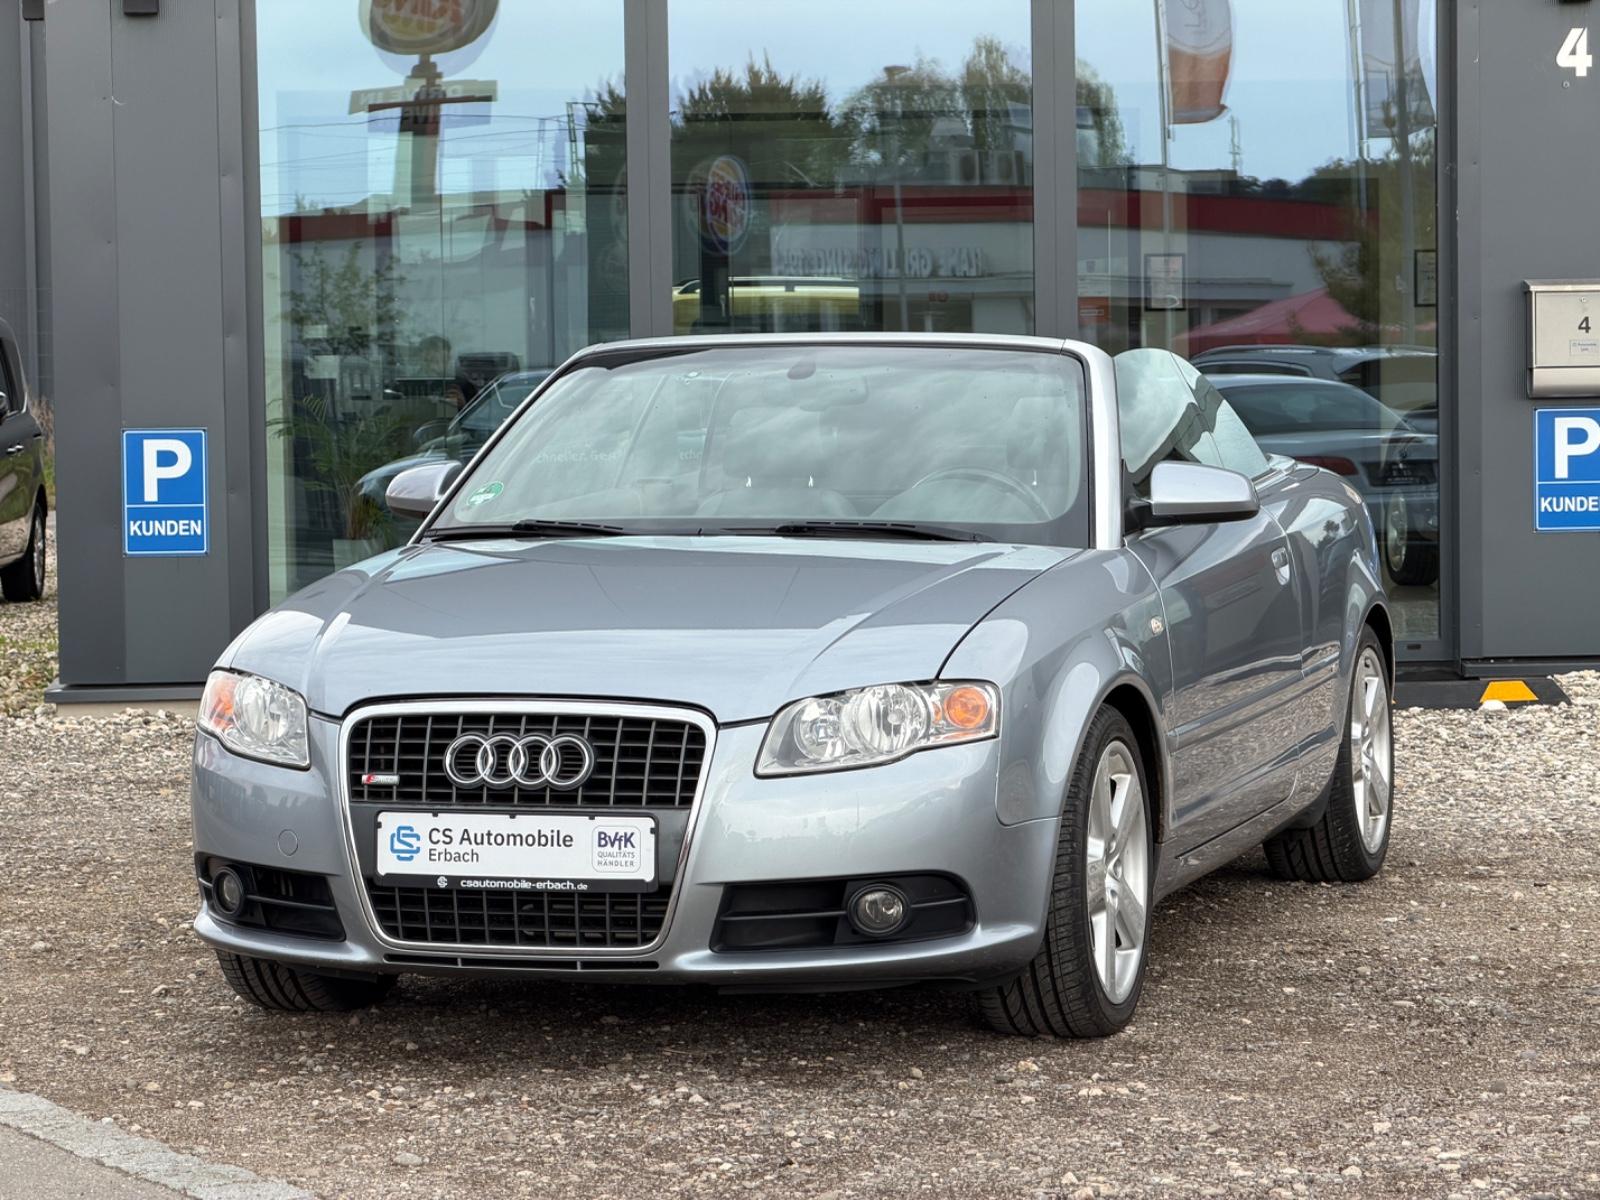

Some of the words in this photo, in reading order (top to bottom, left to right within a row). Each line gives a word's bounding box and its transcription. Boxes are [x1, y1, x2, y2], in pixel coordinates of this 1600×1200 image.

[1556, 27, 1592, 77] 4
[1578, 316, 1591, 334] 4
[1554, 417, 1600, 479] P
[143, 439, 192, 502] P
[1540, 496, 1600, 513] KUNDE
[129, 520, 202, 536] KUNDEN
[428, 828, 454, 845] CS
[459, 829, 574, 848] Automobile
[597, 831, 636, 850] BvfK
[428, 848, 480, 863] Erbach
[597, 851, 636, 860] QUALITÄTS
[597, 860, 635, 868] HÄNDLER
[460, 879, 588, 891] csautomobile-erbach.de
